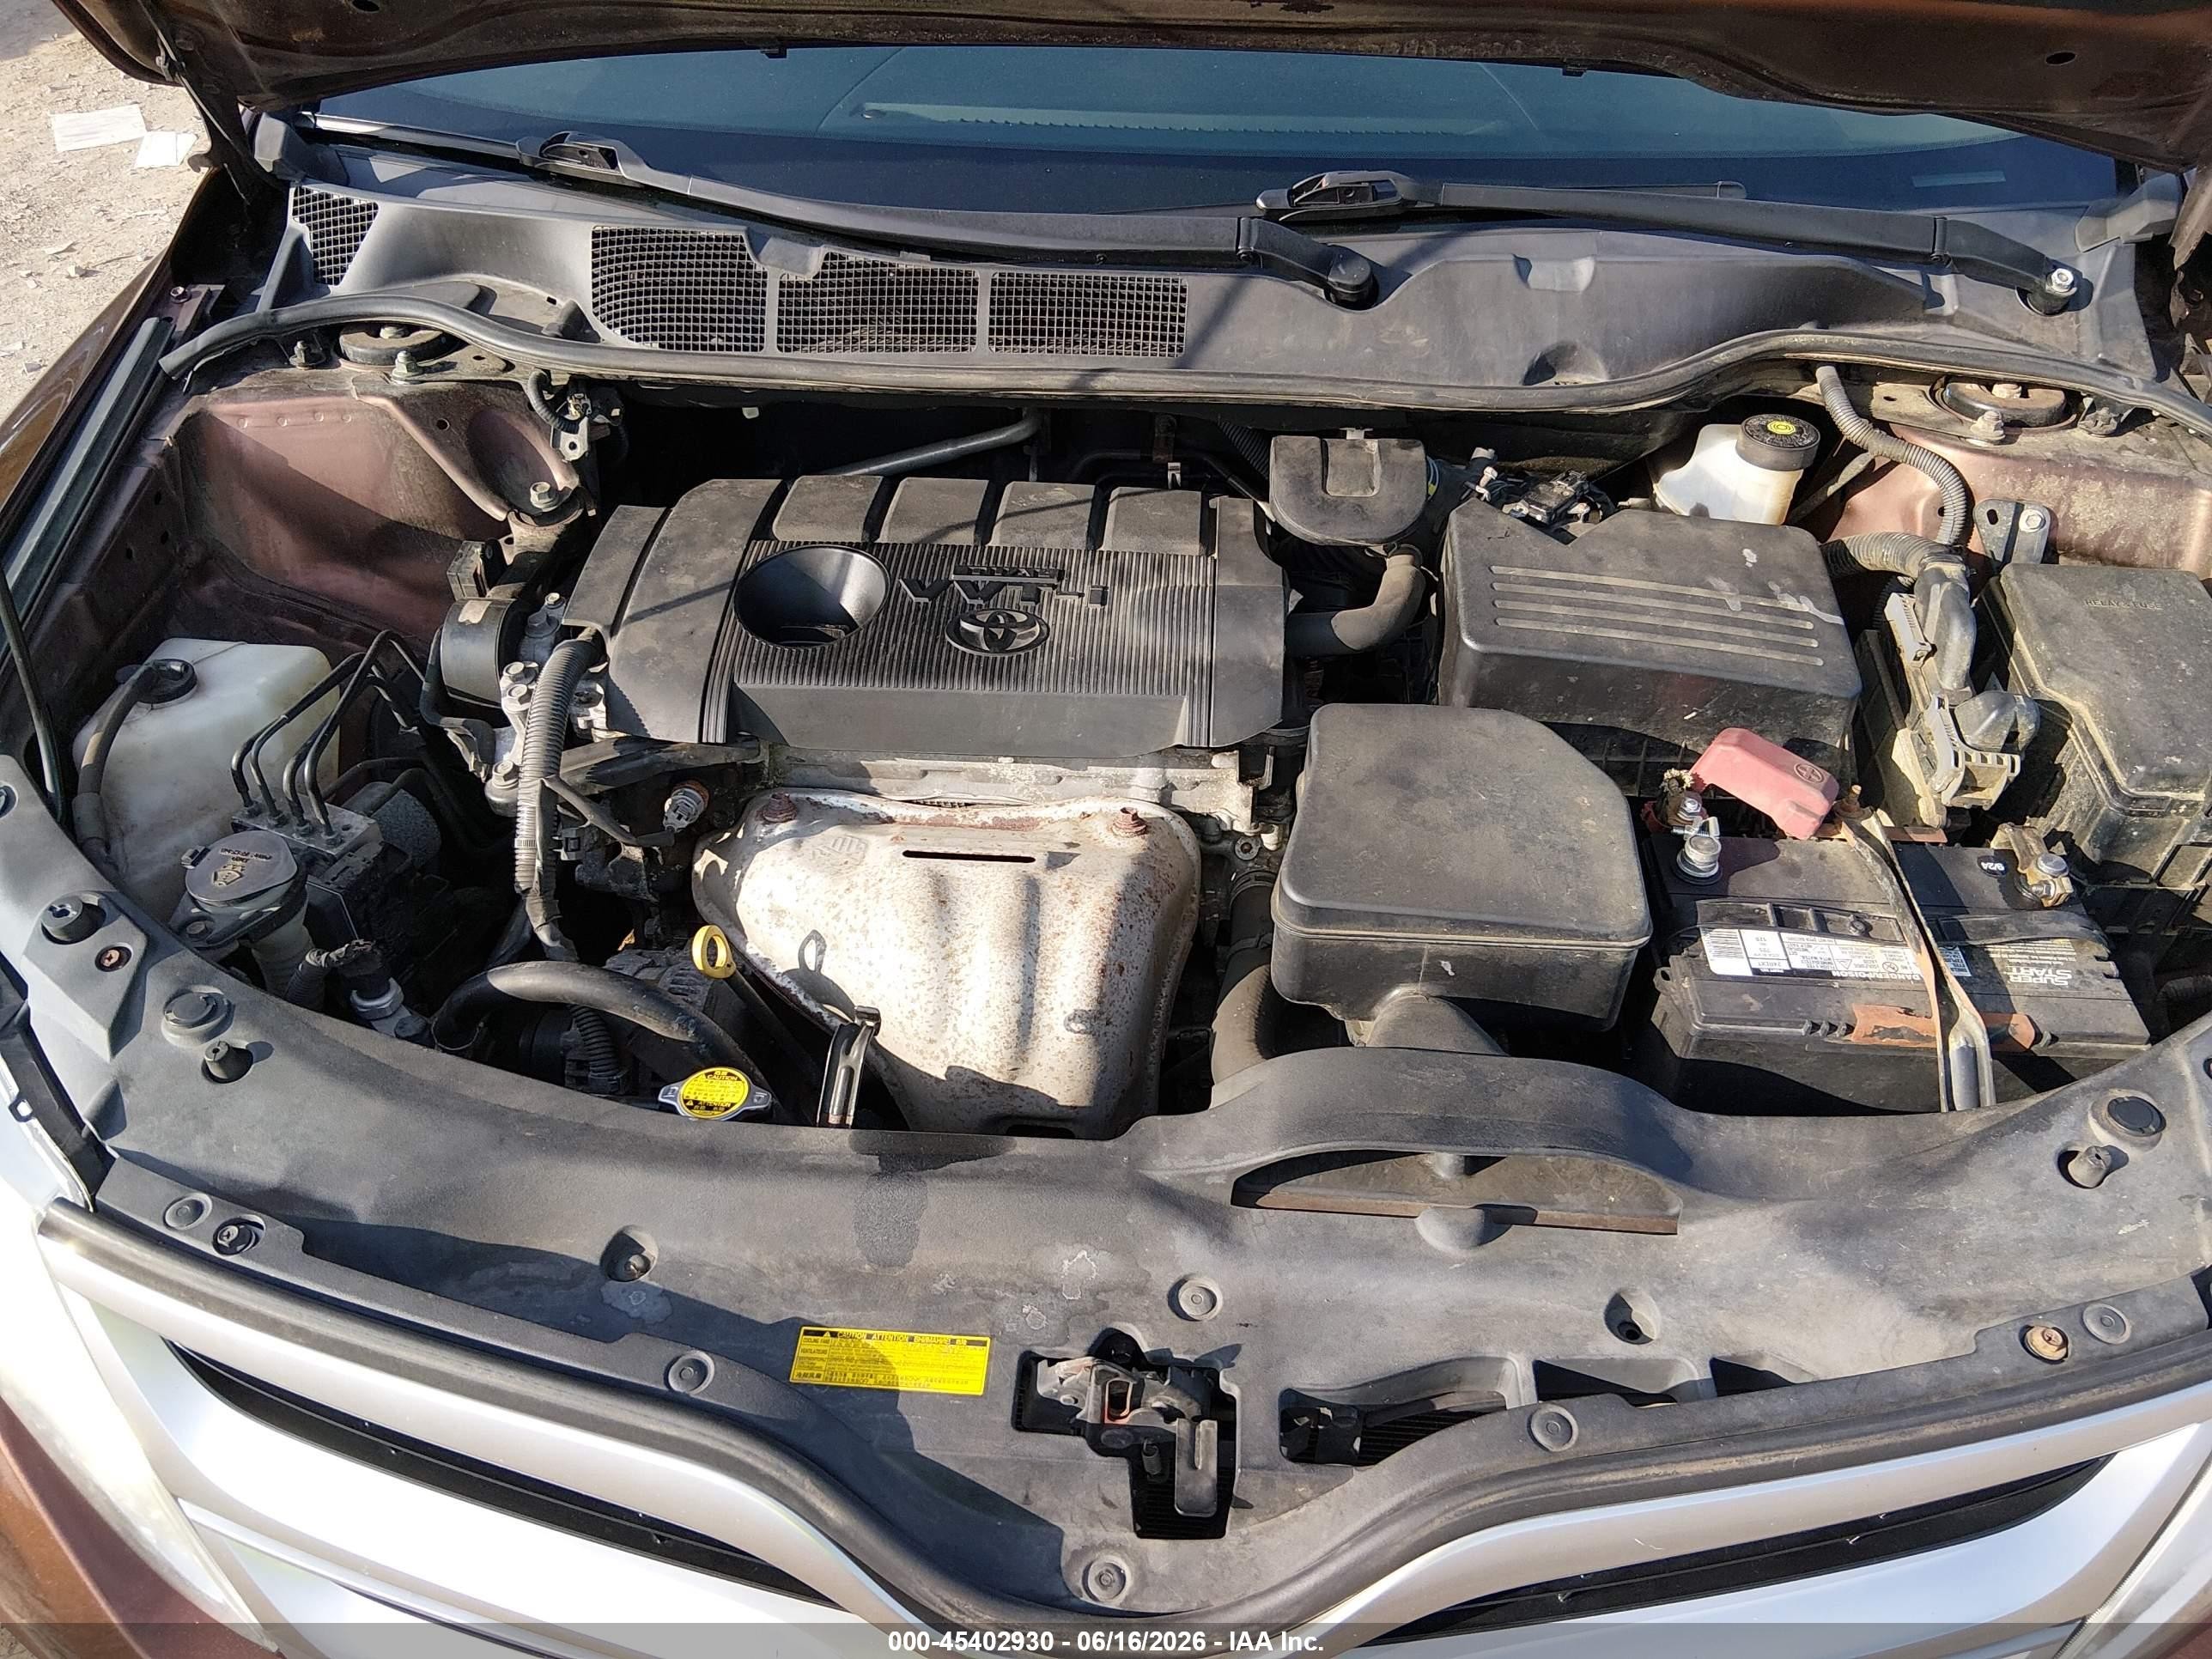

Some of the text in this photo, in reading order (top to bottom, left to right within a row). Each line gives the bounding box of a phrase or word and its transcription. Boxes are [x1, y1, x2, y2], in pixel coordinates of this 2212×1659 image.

[2083, 599, 2118, 608] RELAY
[1980, 861, 2005, 871] 9/24
[2004, 967, 2073, 979] START
[2008, 974, 2069, 986] SUPER
[836, 1331, 908, 1342] CAUTION ATTENTION
